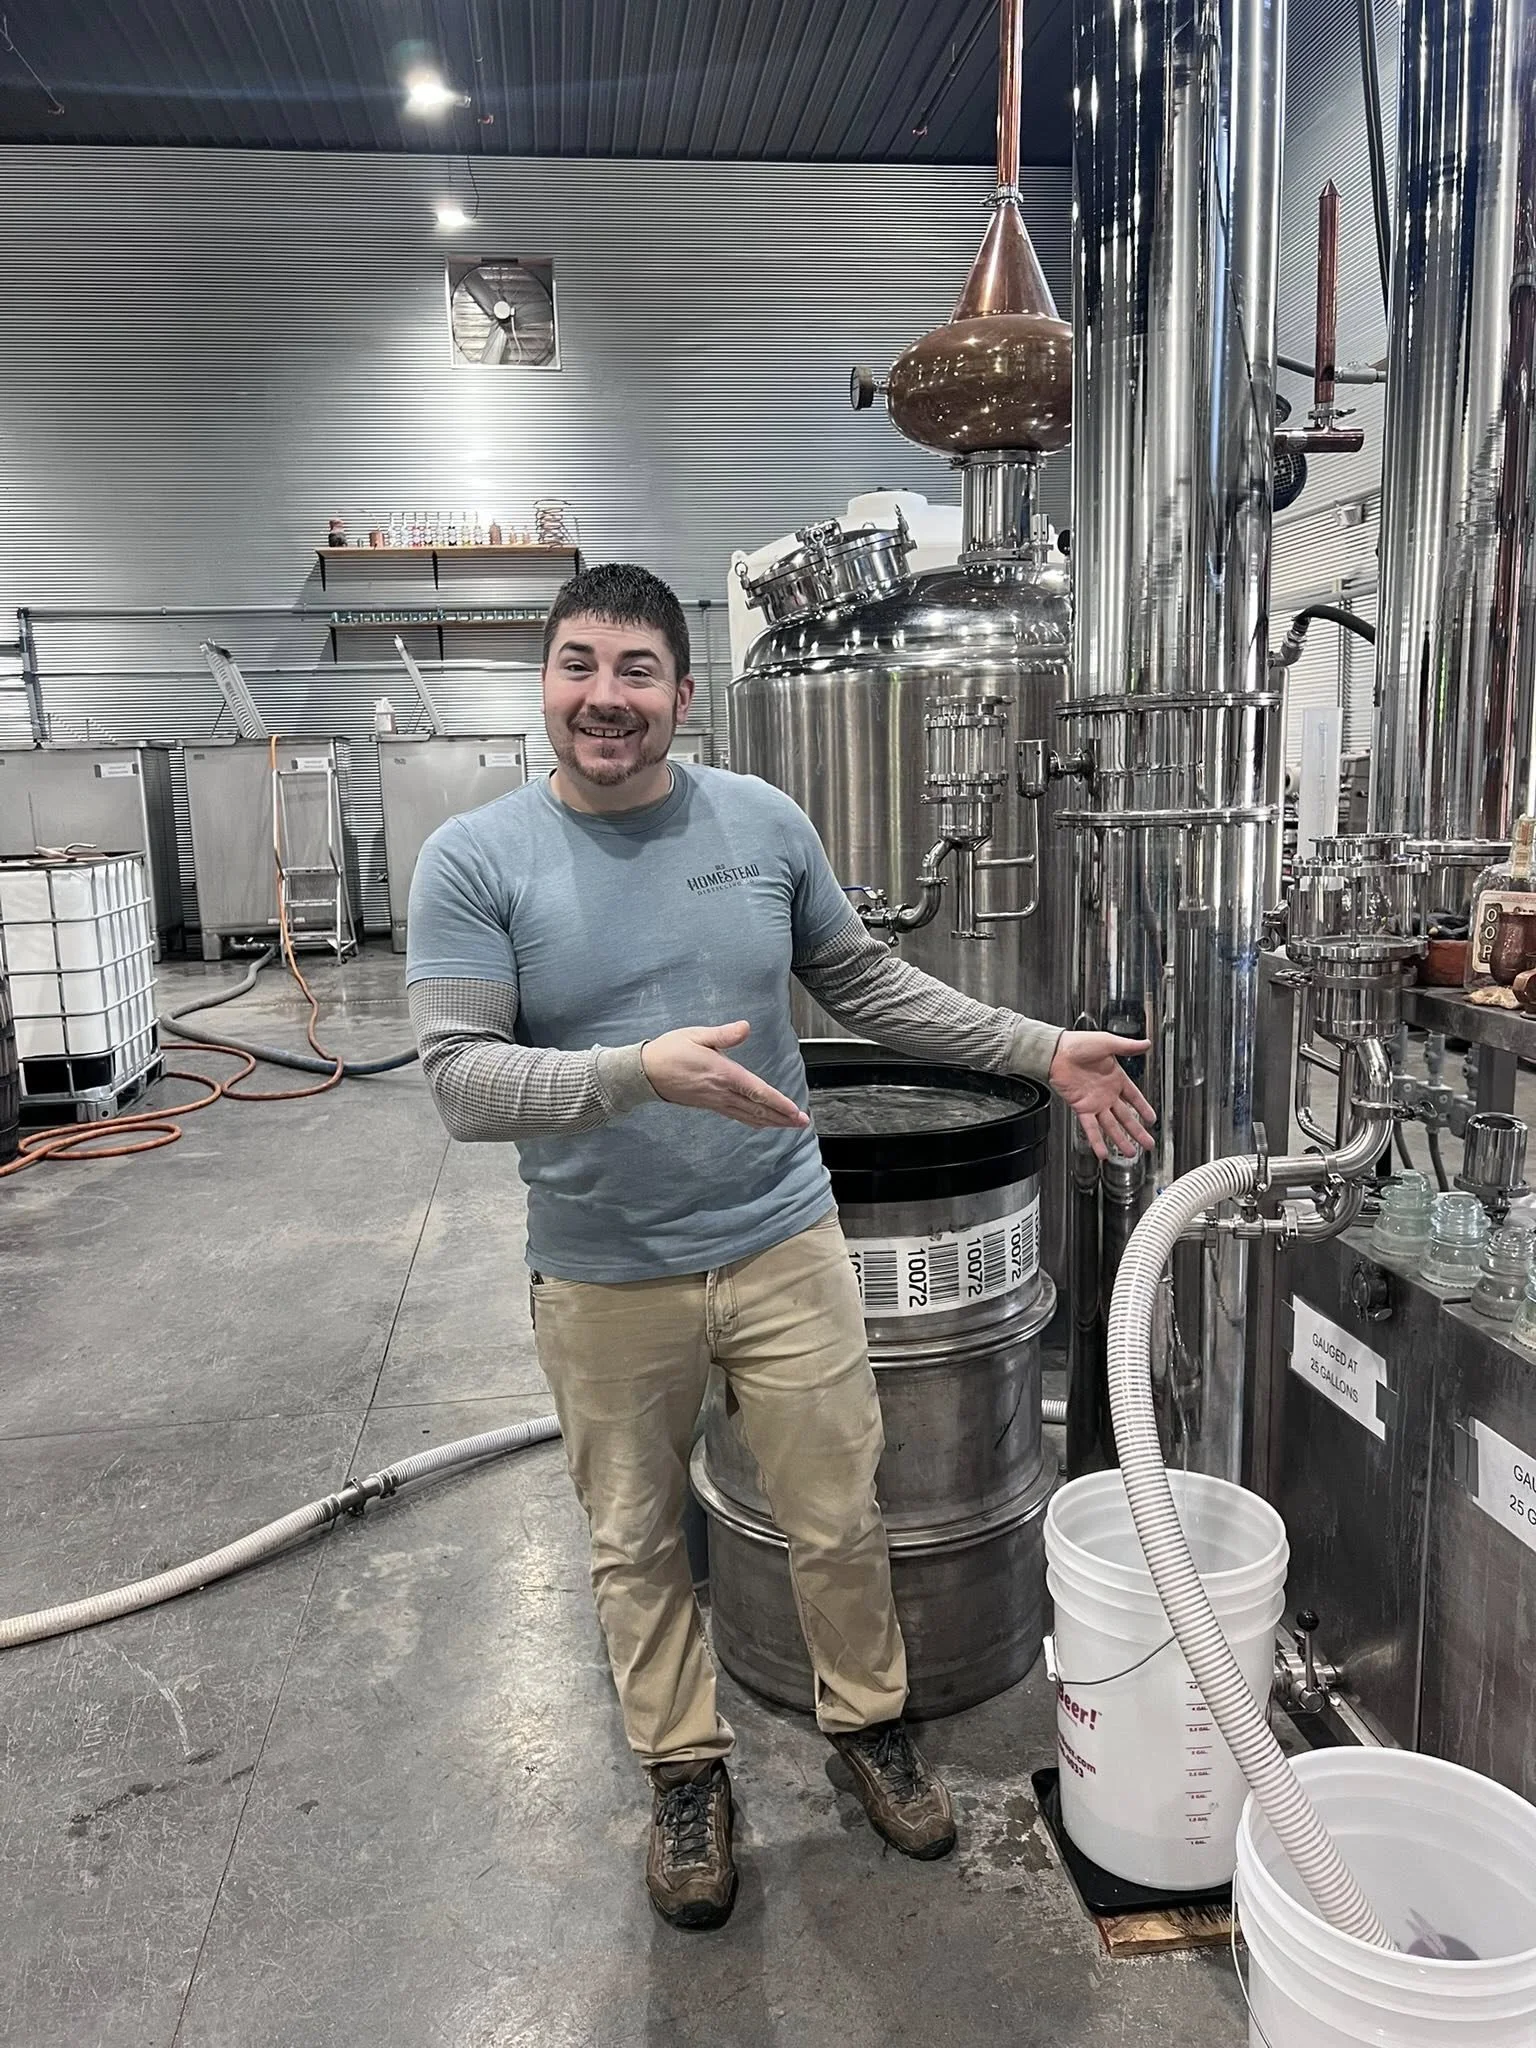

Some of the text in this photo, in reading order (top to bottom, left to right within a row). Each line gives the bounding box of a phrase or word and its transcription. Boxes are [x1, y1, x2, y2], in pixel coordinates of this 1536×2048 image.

[686, 863, 760, 891] HOMESTEAD
[967, 1238, 983, 1297] 10072
[1010, 1224, 1022, 1282] 10072
[908, 1248, 927, 1307] 10072
[1312, 1333, 1358, 1374] GAUGED AT
[1310, 1357, 1359, 1403] 25 GALLONS
[1510, 1494, 1524, 1516] 25
